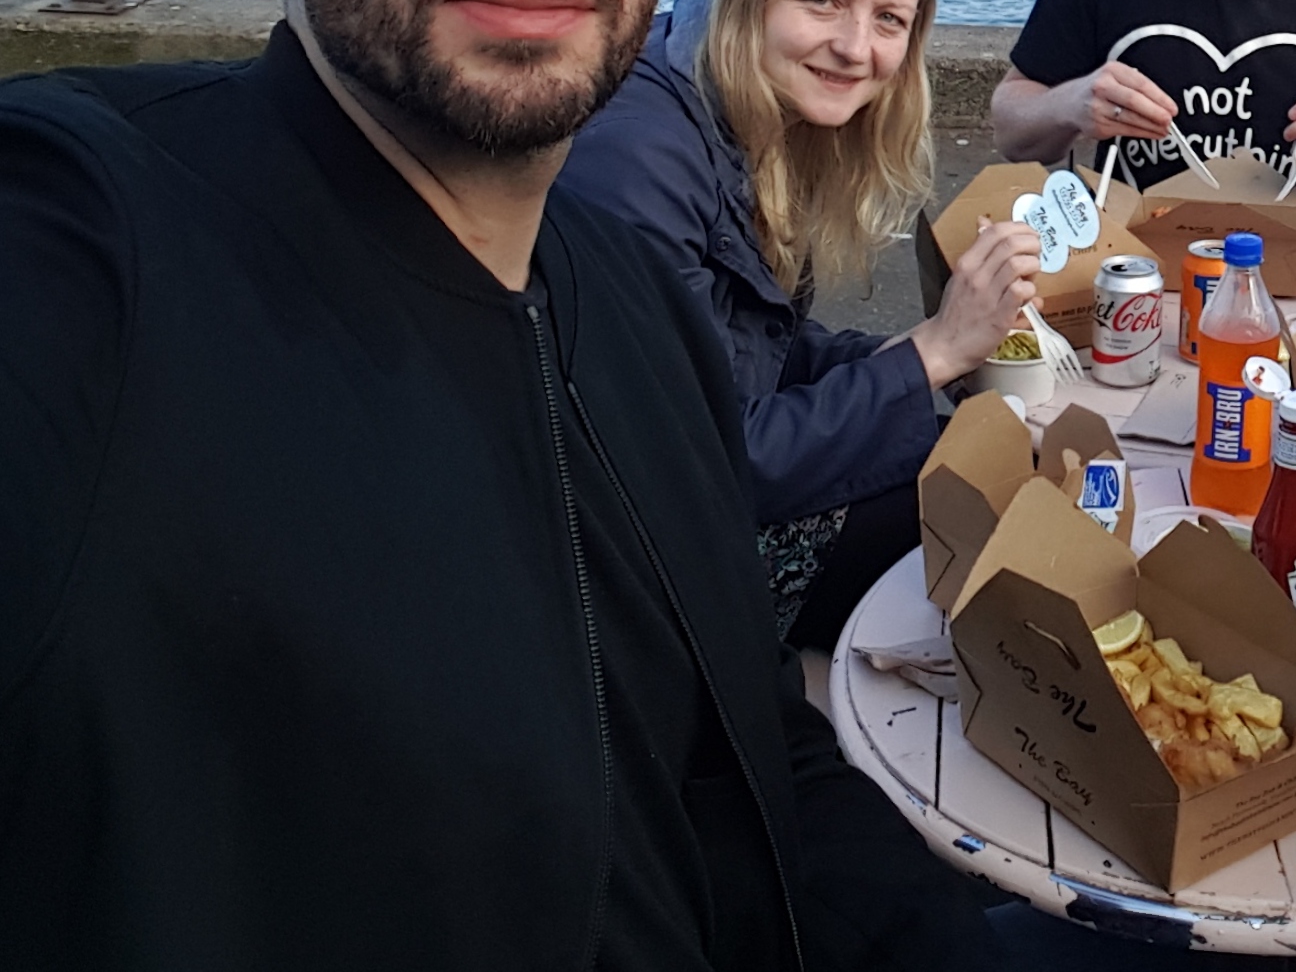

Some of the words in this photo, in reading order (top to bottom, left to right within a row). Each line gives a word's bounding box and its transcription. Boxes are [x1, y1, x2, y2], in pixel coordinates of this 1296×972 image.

[1183, 77, 1253, 120] not
[1050, 683, 1097, 733] The
[1015, 726, 1047, 767] The
[1053, 760, 1092, 806] Bay
